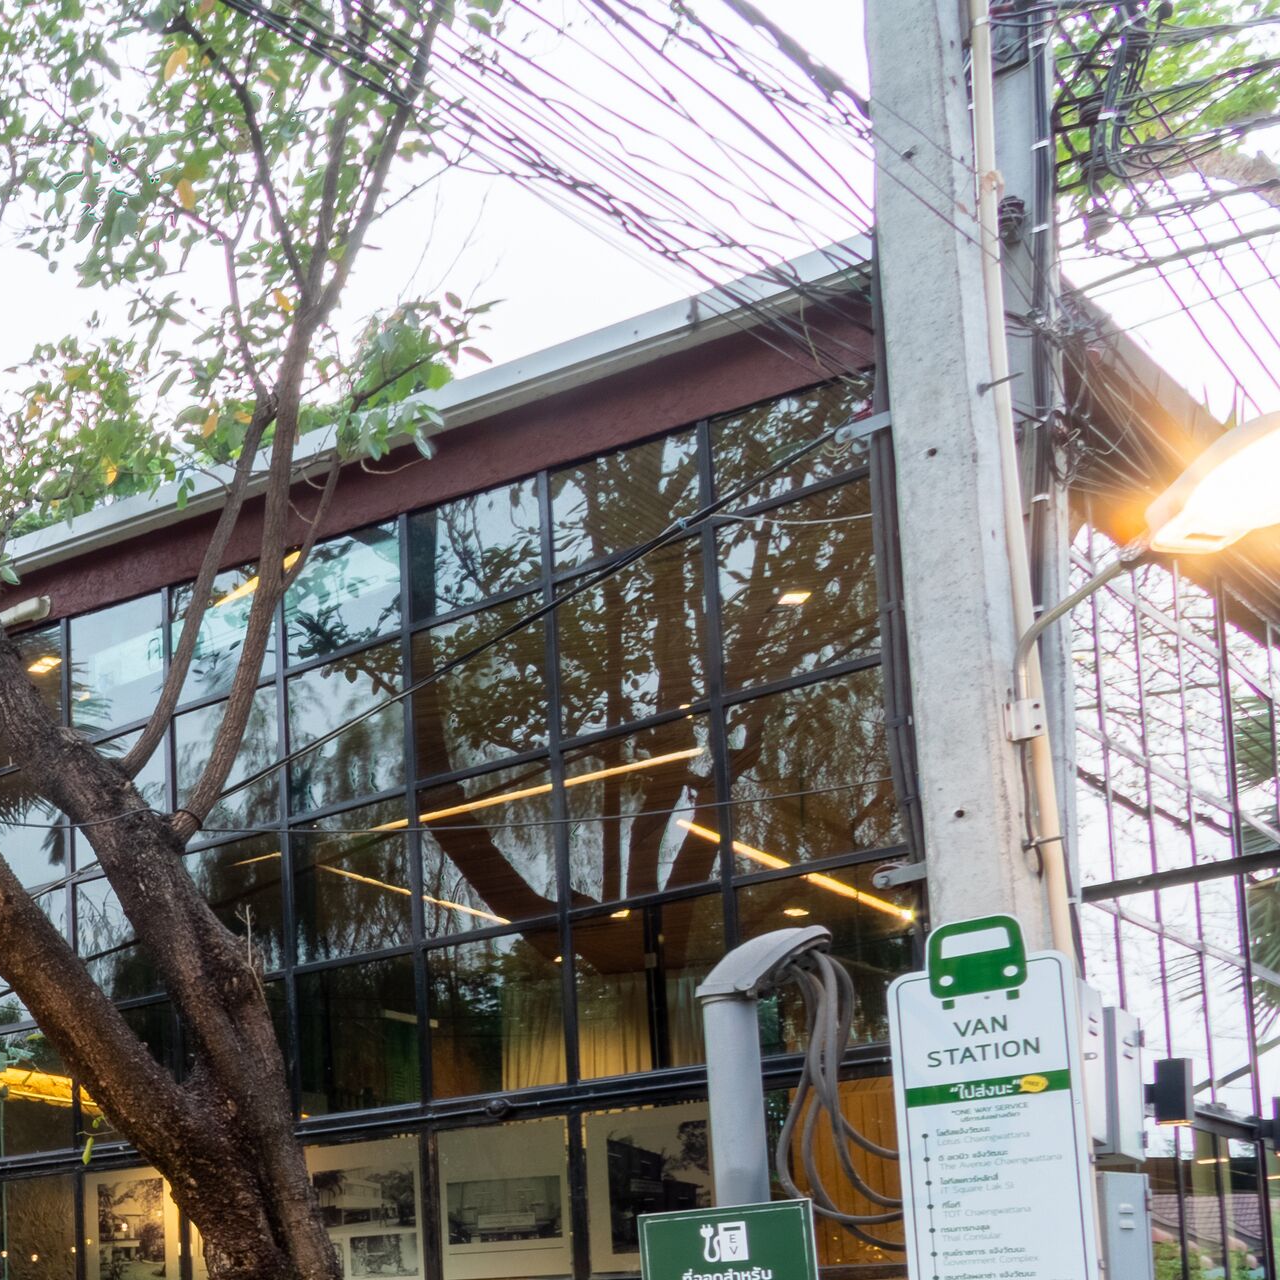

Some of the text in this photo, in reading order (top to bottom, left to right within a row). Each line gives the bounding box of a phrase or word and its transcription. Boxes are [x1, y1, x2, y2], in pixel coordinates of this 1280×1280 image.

[953, 1014, 1008, 1038] VAN
[927, 1037, 1041, 1068] STATION
[995, 1102, 1028, 1111] SERVICE
